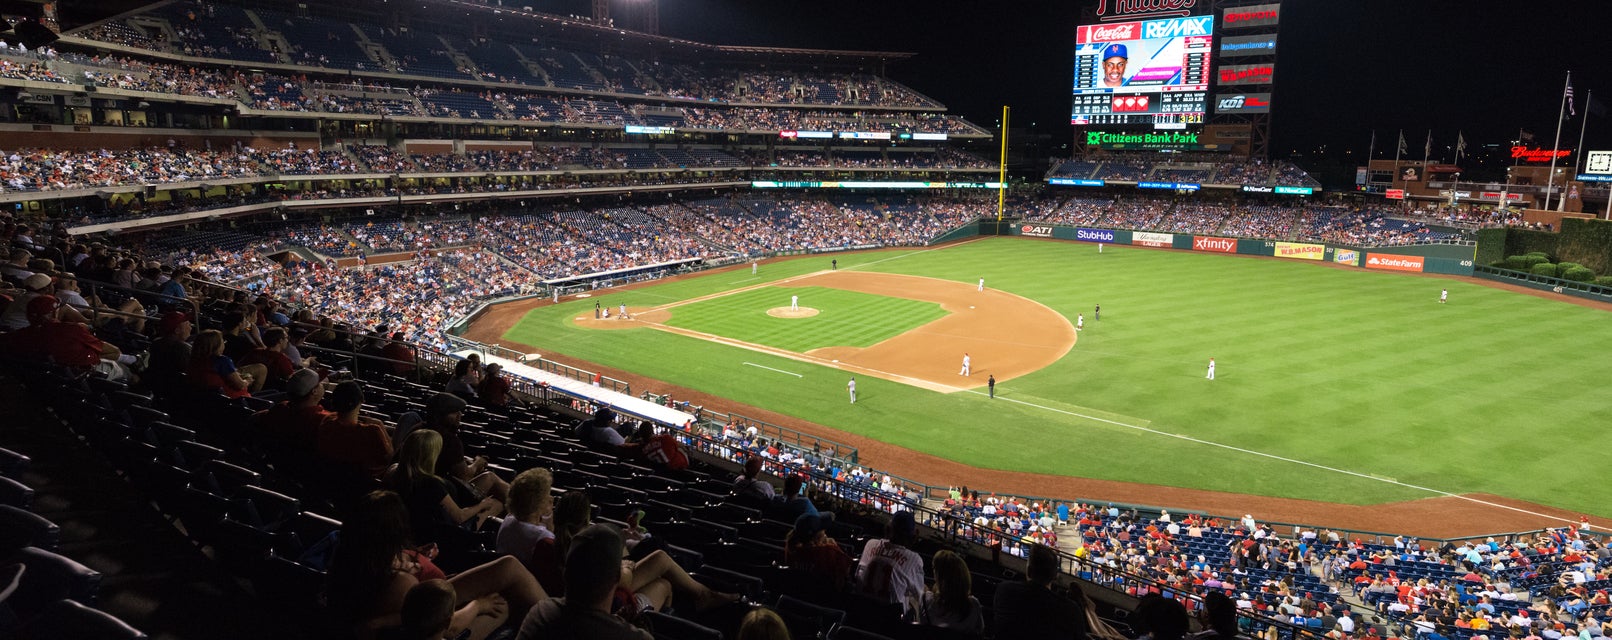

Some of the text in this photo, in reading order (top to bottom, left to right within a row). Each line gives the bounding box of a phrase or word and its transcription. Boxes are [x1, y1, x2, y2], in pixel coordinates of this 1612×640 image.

[1236, 9, 1277, 21] TOYOTA
[1145, 18, 1207, 38] RE/MAX
[1102, 132, 1198, 143] Citizens Bank Park
[1510, 146, 1571, 158] Budweser
[1077, 230, 1114, 240] StubHub
[1196, 238, 1234, 252] xfinity
